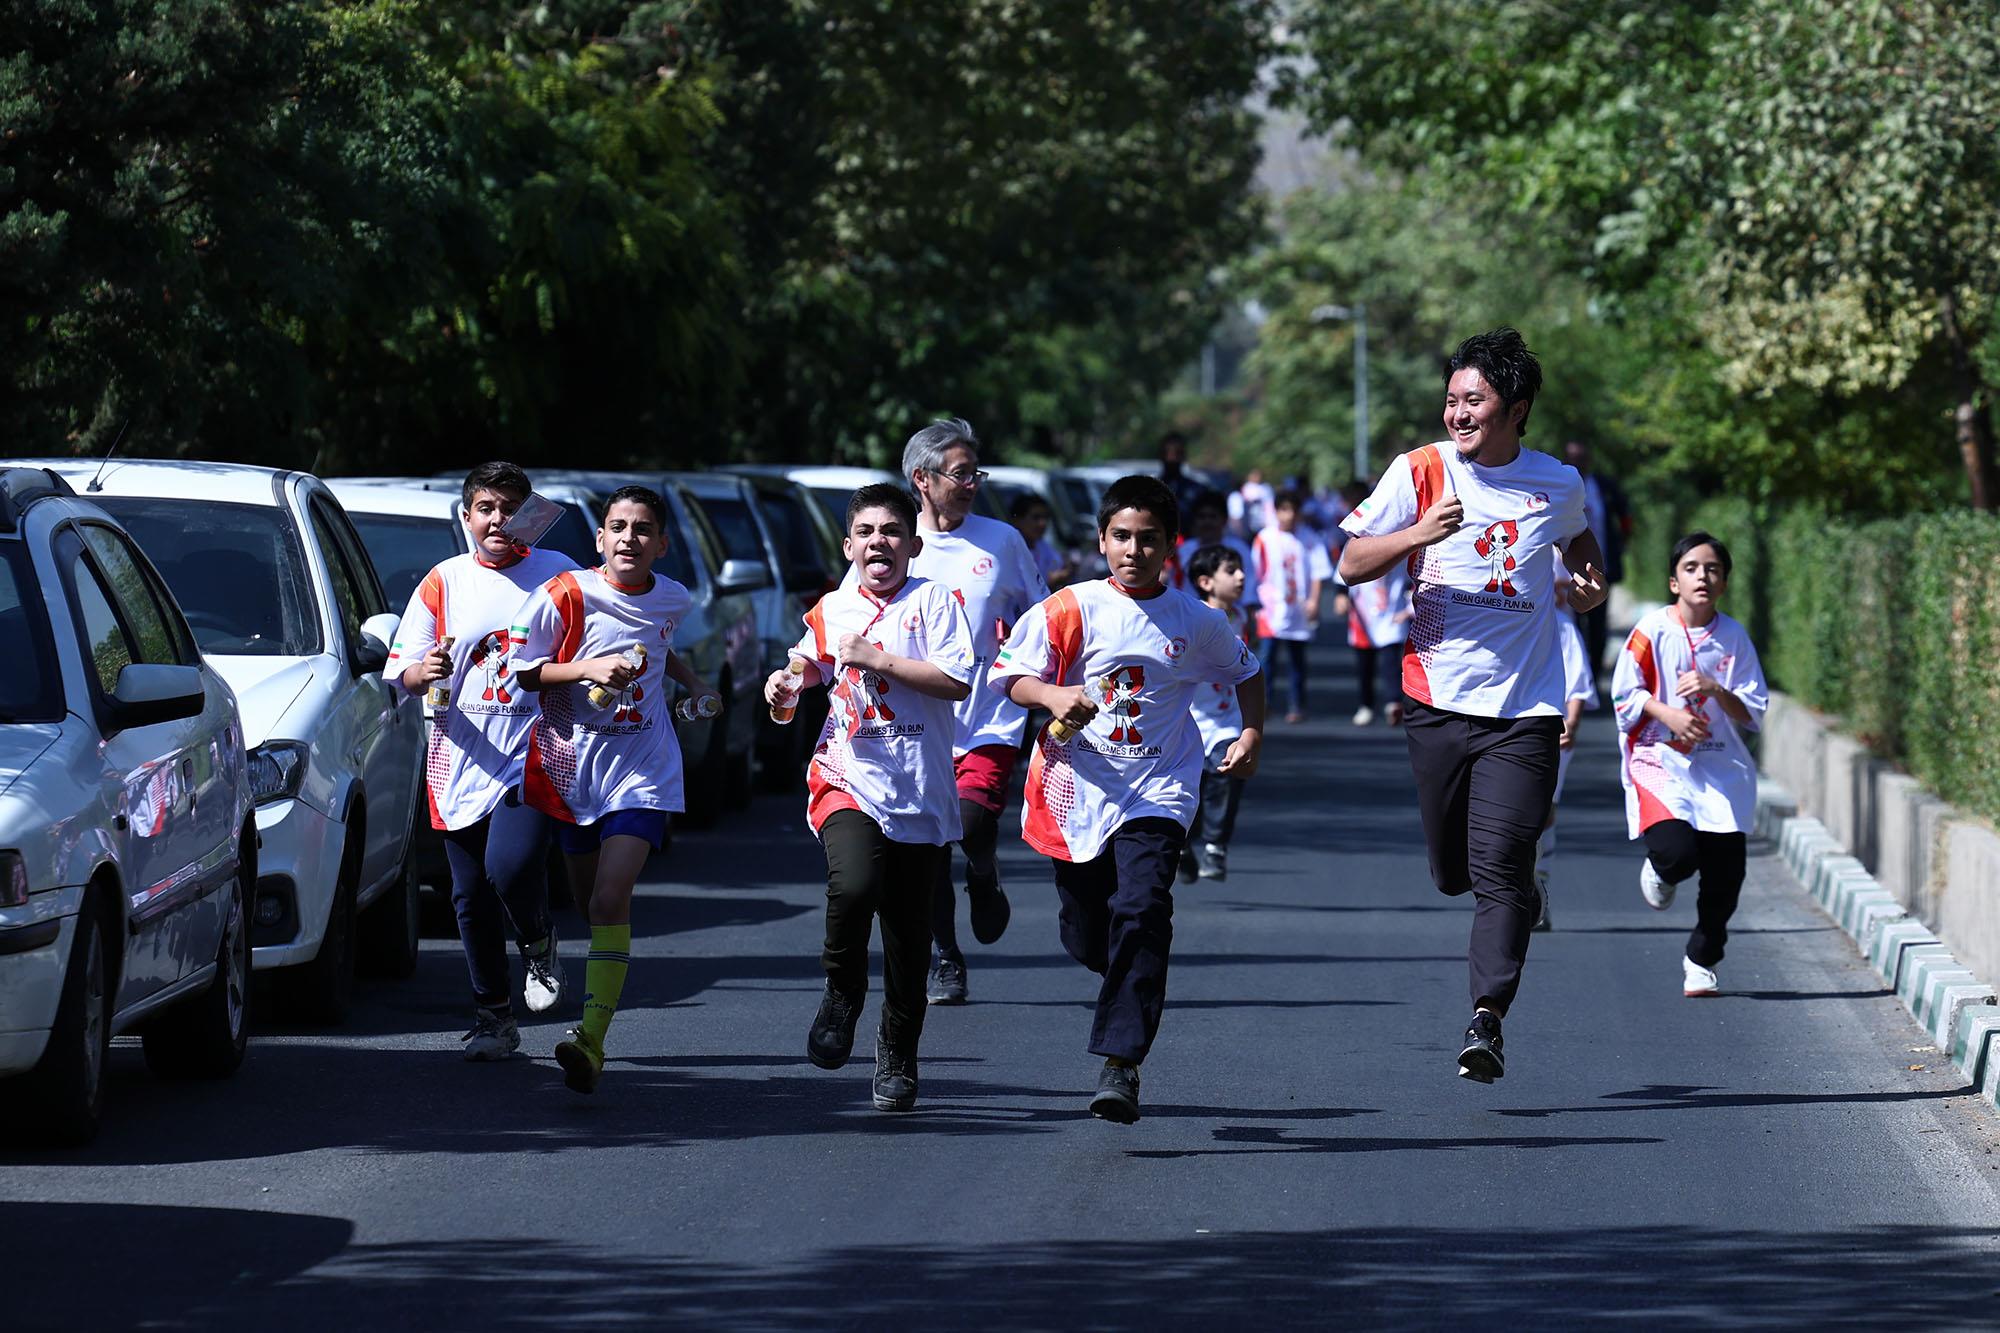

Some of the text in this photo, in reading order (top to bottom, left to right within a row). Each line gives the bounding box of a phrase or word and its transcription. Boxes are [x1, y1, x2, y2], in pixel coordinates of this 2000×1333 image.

[1451, 593, 1535, 610] ASIAN GAMES FUN RUN
[476, 703, 499, 713] GAMES
[502, 705, 517, 714] FUN
[600, 725, 625, 734] GAMES
[861, 727, 887, 735] GAMES
[890, 725, 905, 734] FUN
[908, 724, 924, 733] RUN
[1077, 740, 1162, 756] ASIAN GAMES FUN RUN
